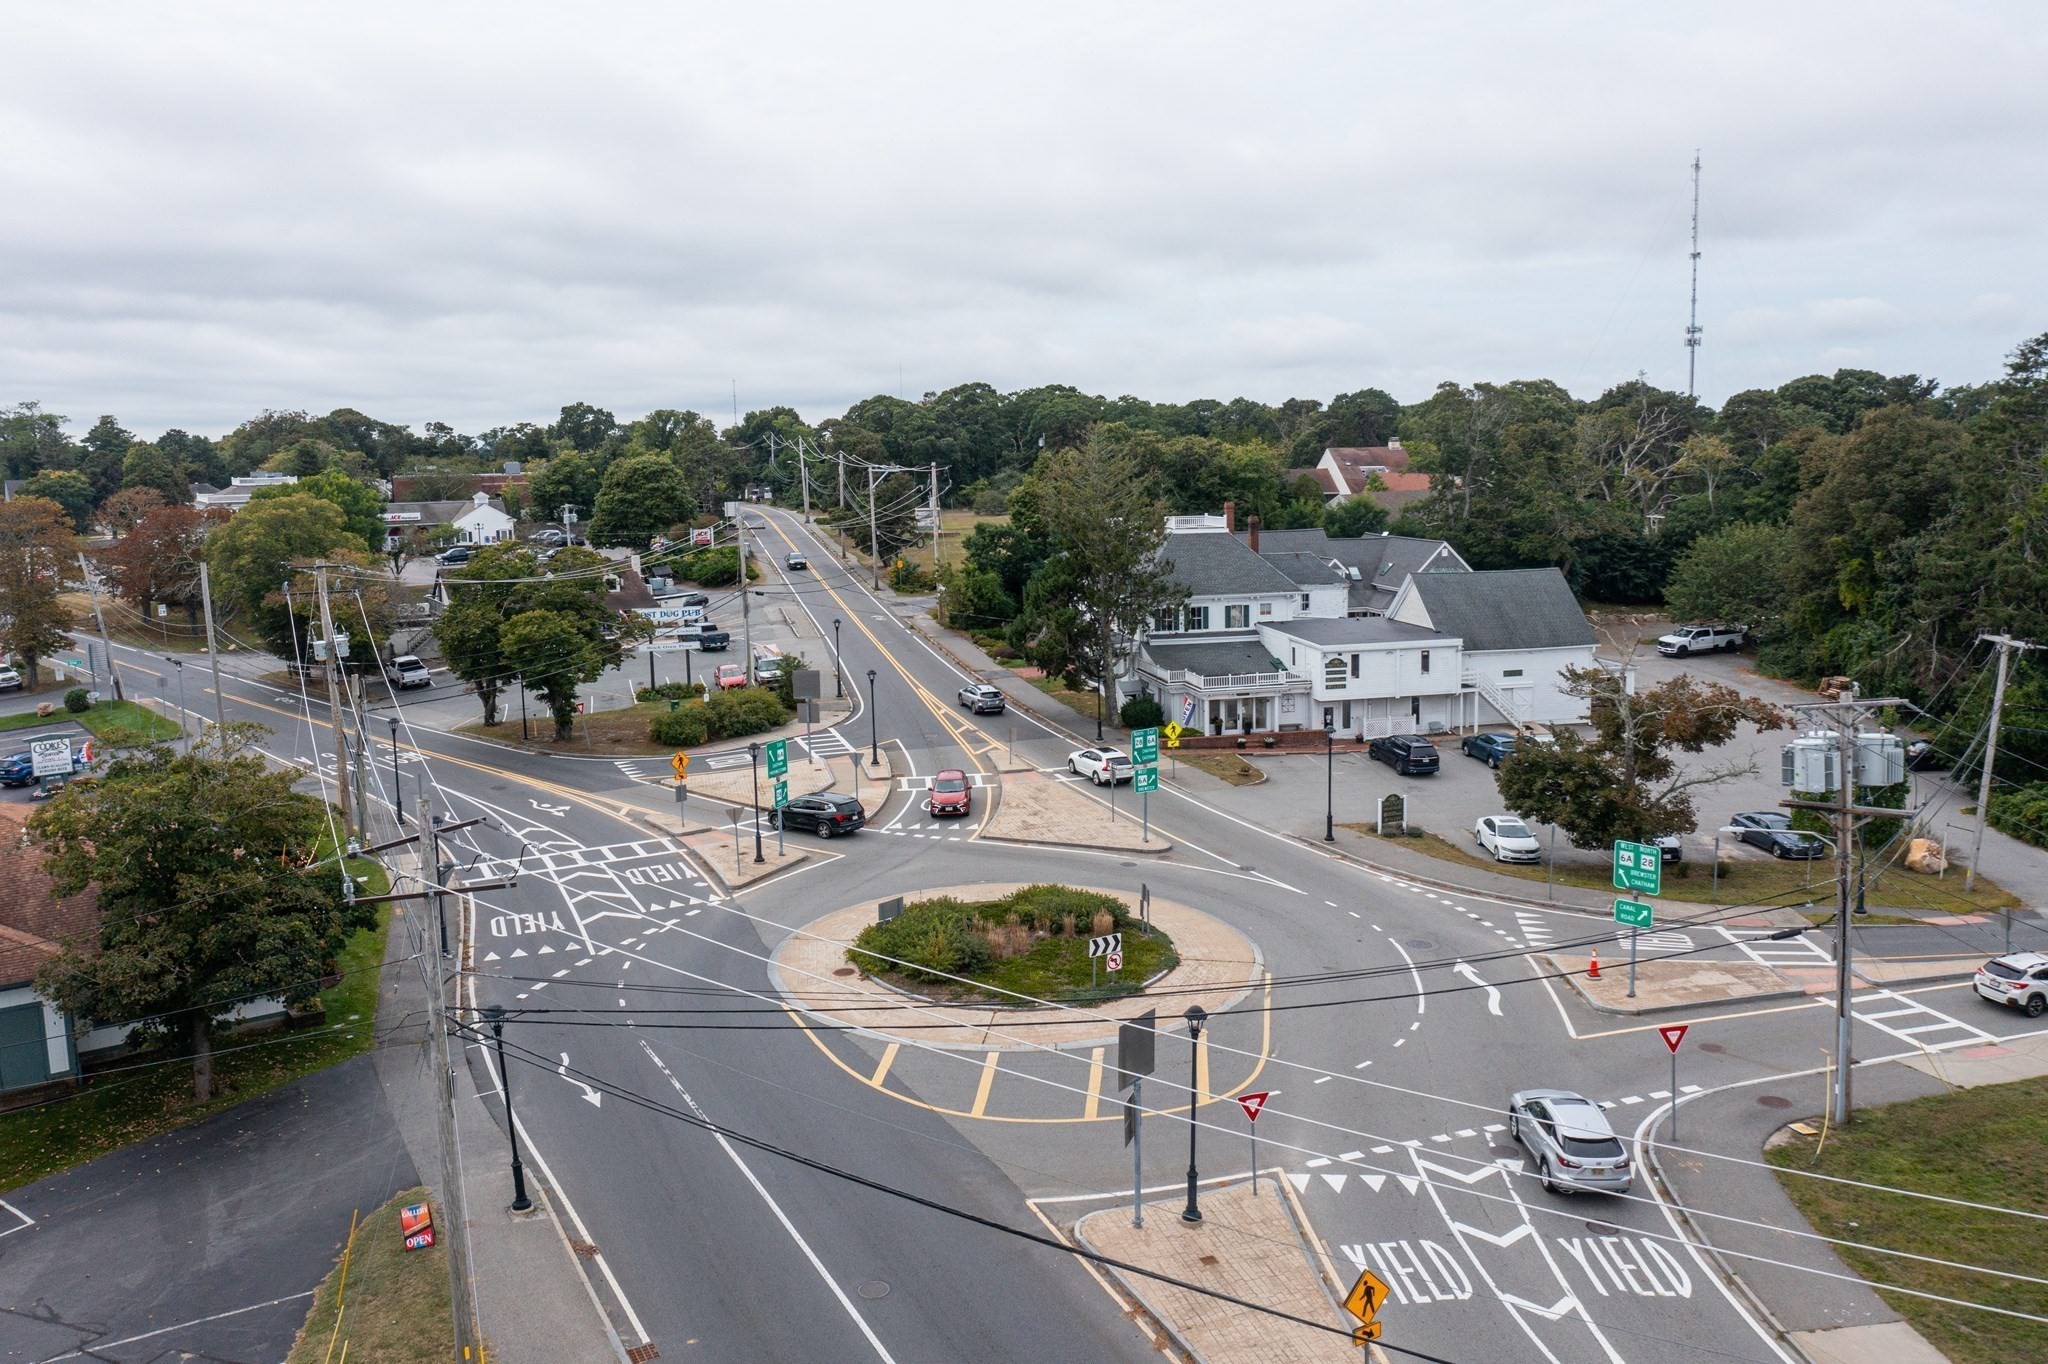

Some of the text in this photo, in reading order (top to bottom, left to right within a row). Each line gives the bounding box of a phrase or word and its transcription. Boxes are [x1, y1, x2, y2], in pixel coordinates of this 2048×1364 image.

[682, 610, 700, 618] PUB
[1640, 846, 1657, 854] NORTH
[1621, 854, 1653, 867] 6A 28
[626, 862, 699, 885] YIELD
[1630, 869, 1656, 880] BREWSTER
[1631, 879, 1655, 888] CHATHAM
[1620, 904, 1636, 912] CANAL
[1620, 913, 1635, 921] ROAD
[490, 911, 566, 937] YIELD
[402, 1207, 426, 1217] GALLERY
[406, 1234, 431, 1247] OPEN
[1341, 1240, 1473, 1304] YIELD
[1557, 1237, 1692, 1298] YIELD
